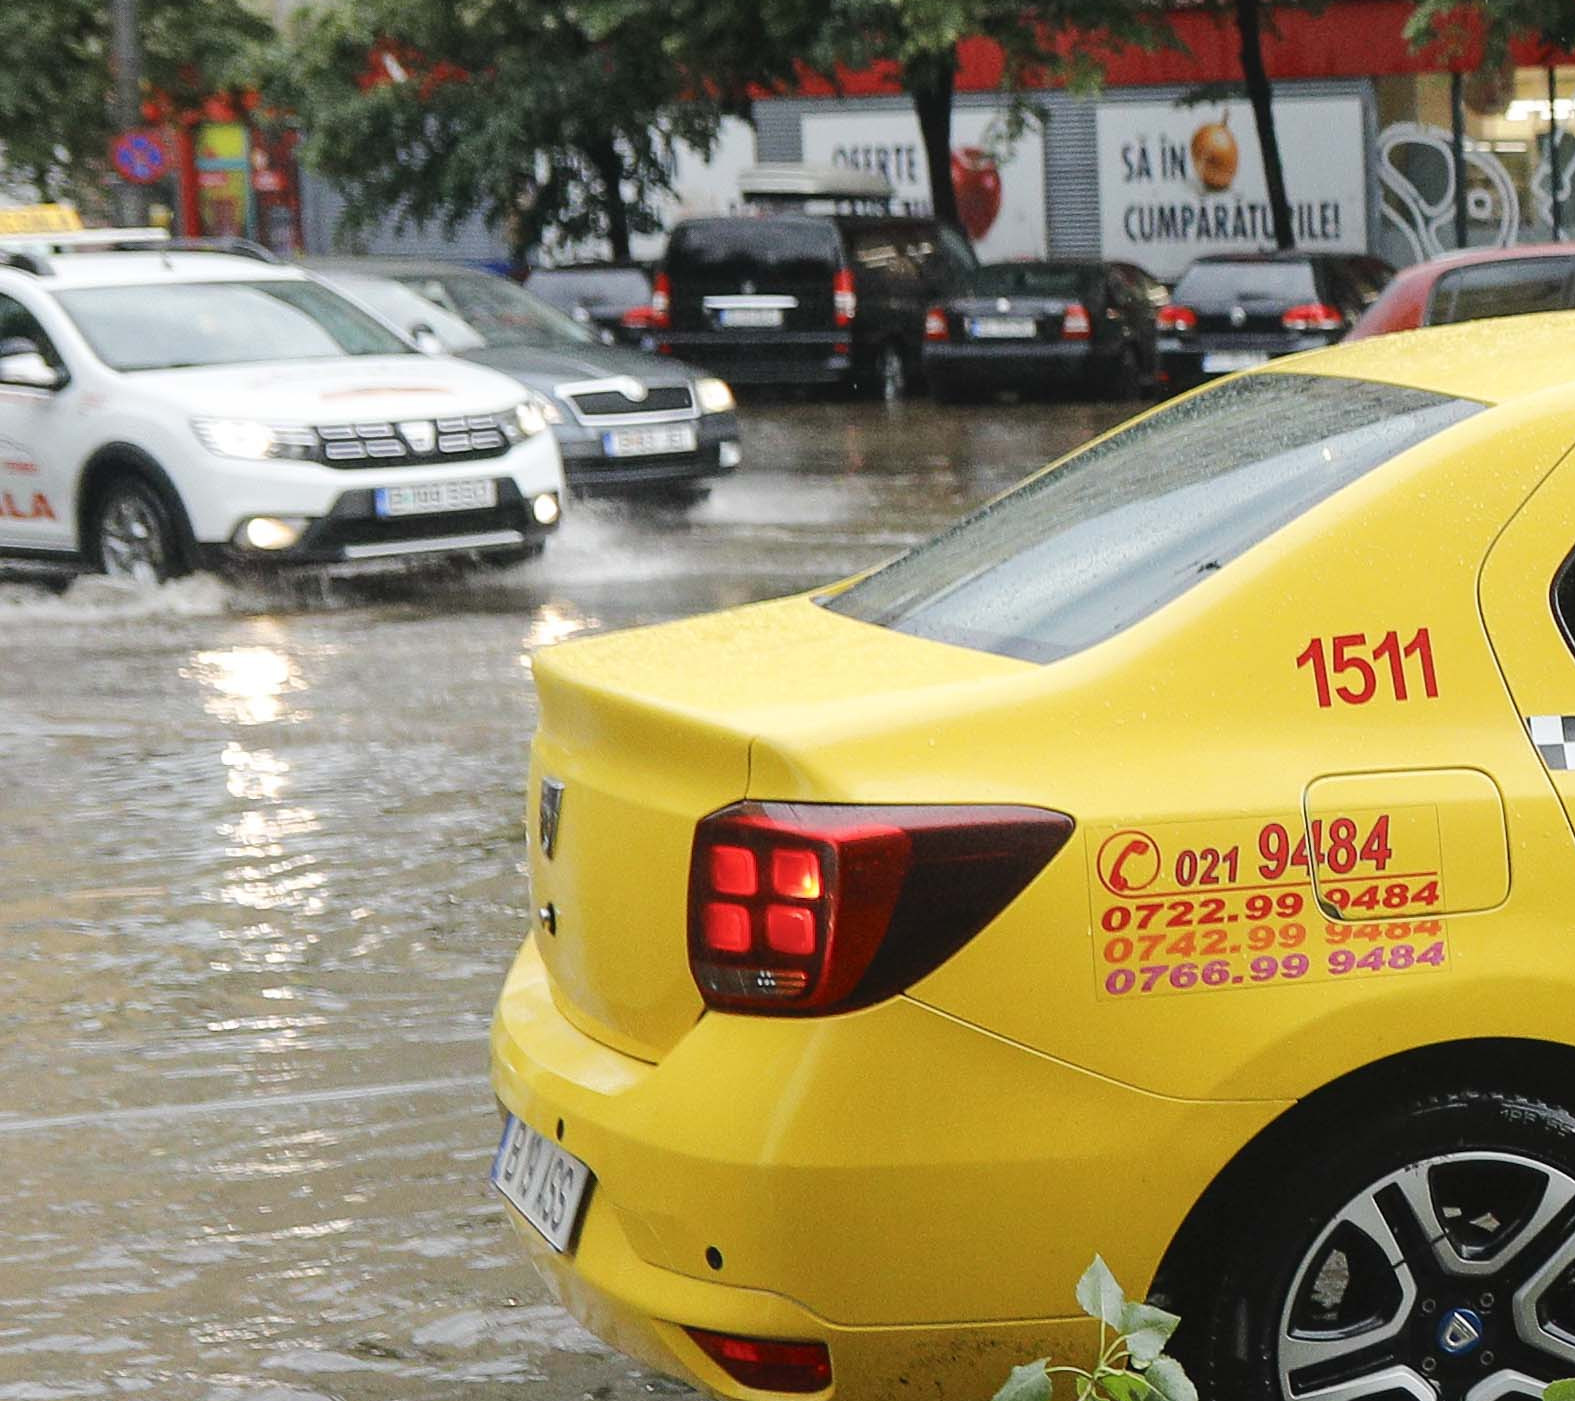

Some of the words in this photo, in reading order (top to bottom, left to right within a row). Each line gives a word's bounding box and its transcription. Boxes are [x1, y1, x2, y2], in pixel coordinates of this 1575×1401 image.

[1124, 193, 1341, 241] CUMPĂRĂTUILE!
[1296, 627, 1439, 708] 1511
[1175, 846, 1239, 887] 021
[1258, 814, 1392, 880] 9484
[1100, 892, 1304, 933] 0722.99
[1323, 880, 1440, 911] 9484
[1103, 923, 1307, 964] 0742.99
[1324, 918, 1442, 945] 9484
[1105, 953, 1310, 996] 0766.99
[1327, 941, 1446, 975] 9484
[504, 1120, 527, 1183] B
